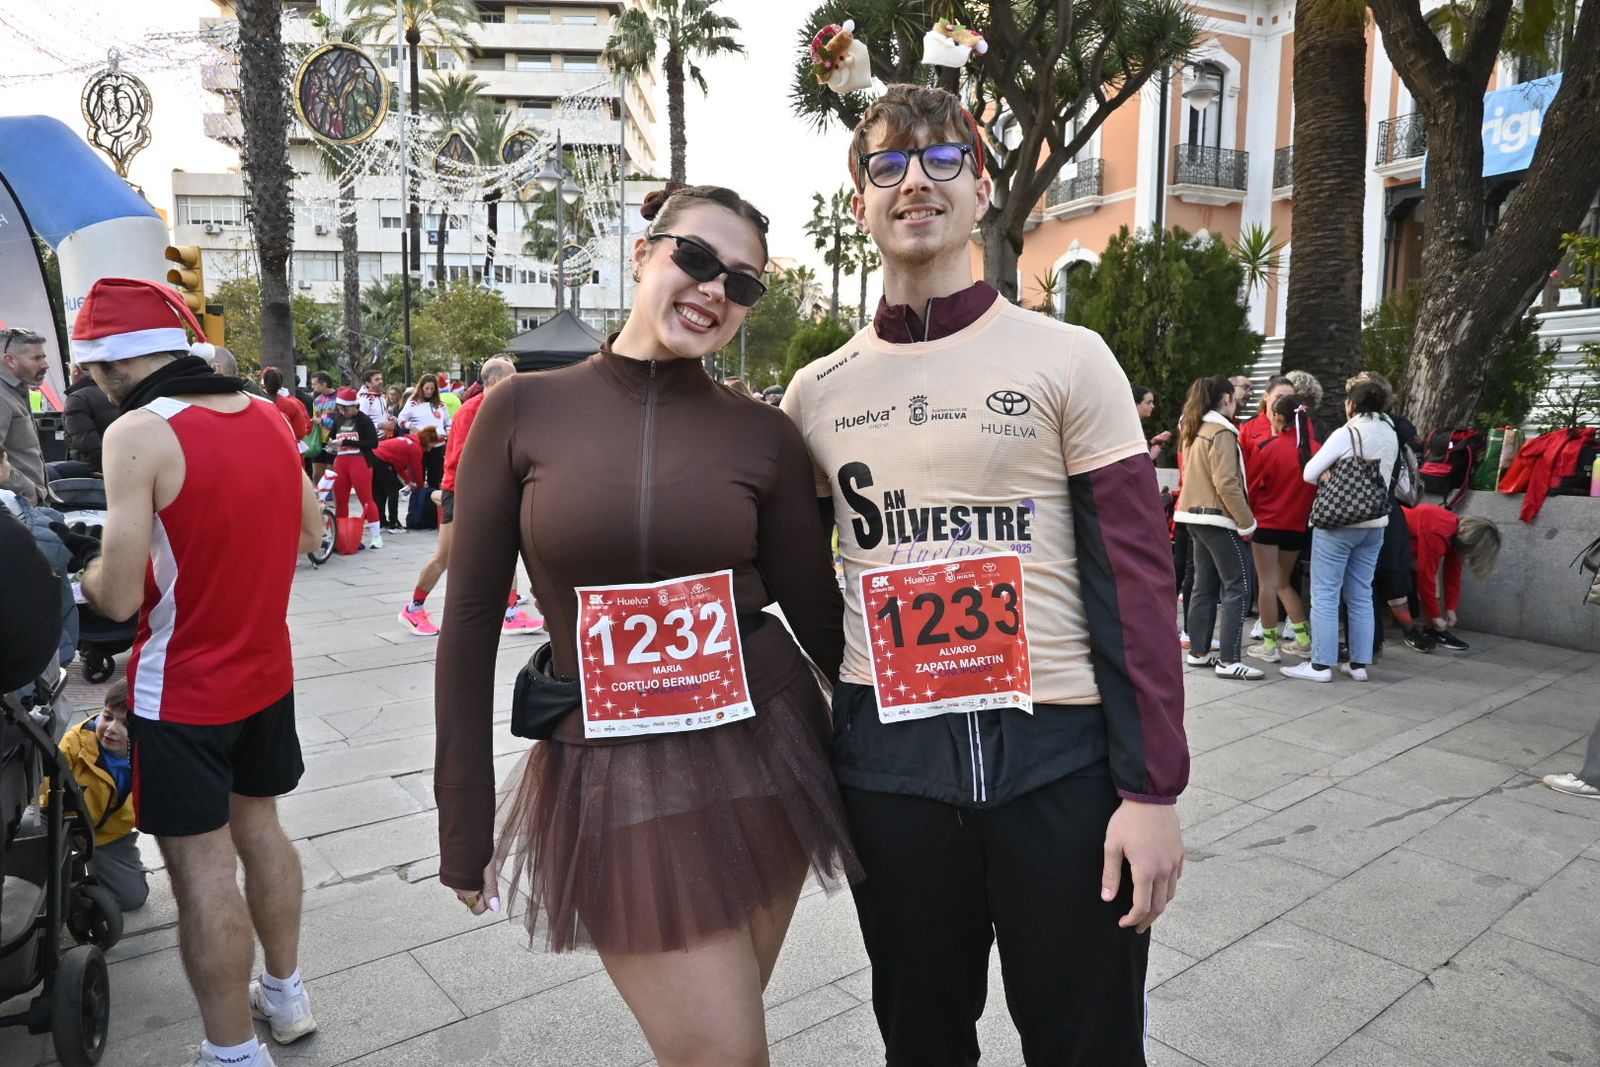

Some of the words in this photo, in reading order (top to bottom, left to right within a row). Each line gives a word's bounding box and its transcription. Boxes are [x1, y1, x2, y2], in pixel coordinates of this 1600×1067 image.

[835, 409, 890, 433] Huelva
[931, 412, 967, 421] HUELVA
[981, 422, 1037, 439] HUELVA
[890, 523, 985, 564] Huelva
[1010, 543, 1032, 554] 2025
[904, 574, 936, 586] Huelva
[617, 597, 649, 606] Huelva
[877, 583, 1020, 648] 1233
[588, 602, 732, 666] 1232
[939, 645, 977, 656] ALVARO
[652, 664, 683, 675] MARIA
[915, 660, 957, 673] ZAPATA
[959, 653, 1004, 669] MARTIN
[611, 679, 660, 692] CORTIJO
[662, 670, 721, 688] BERMUDEZ
